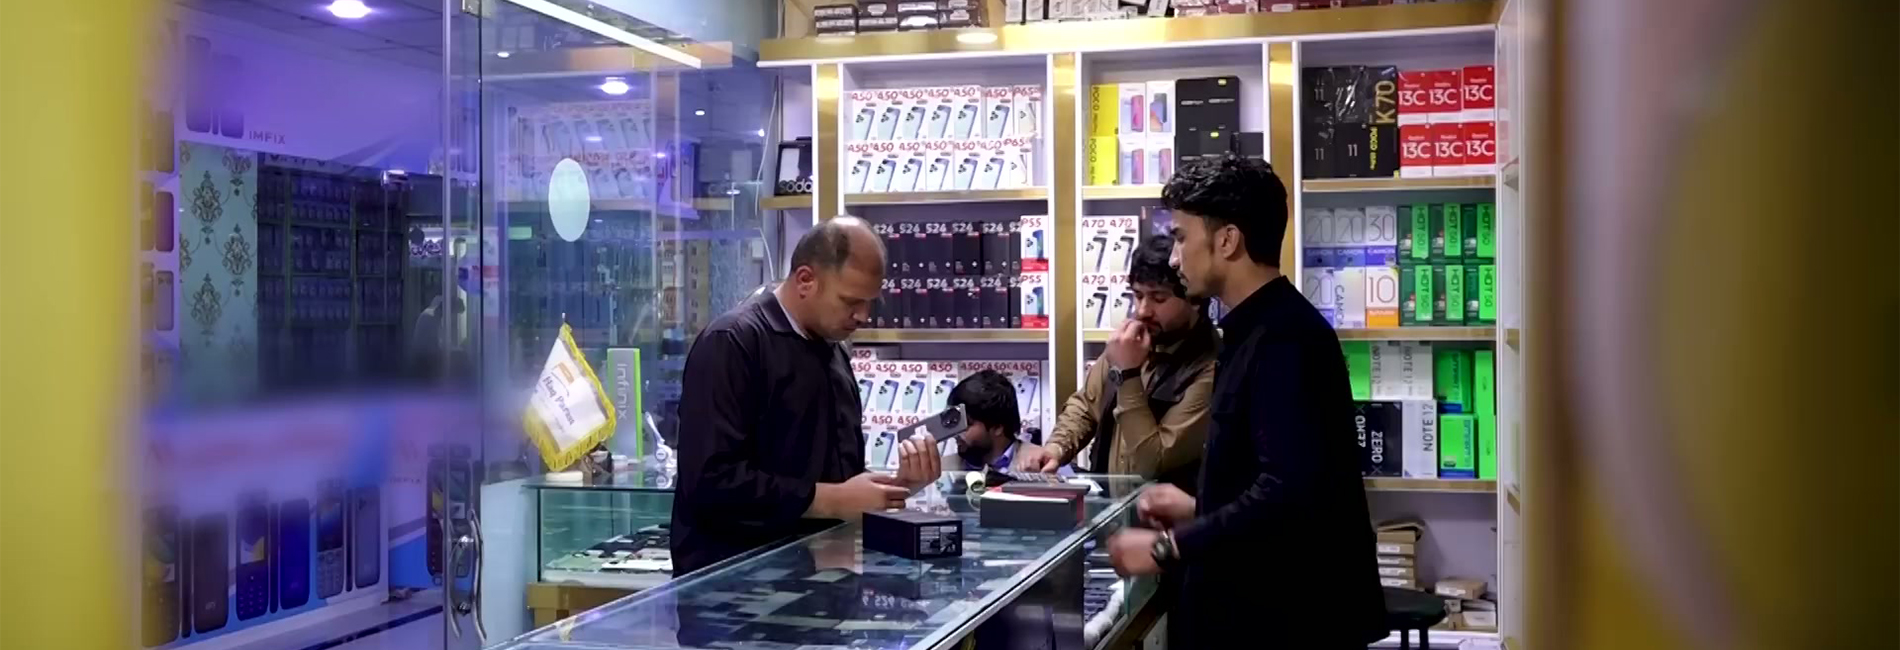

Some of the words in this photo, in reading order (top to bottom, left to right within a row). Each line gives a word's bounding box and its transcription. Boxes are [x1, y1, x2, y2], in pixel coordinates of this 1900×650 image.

[1398, 90, 1426, 106] 13C
[1429, 88, 1457, 105] 13C
[1464, 84, 1493, 101] 13C
[1375, 80, 1395, 123] K70
[1314, 148, 1324, 160] 11
[1348, 144, 1358, 157] 11
[1402, 141, 1431, 159] 13C
[1434, 141, 1463, 158] 13C
[1466, 140, 1495, 157] 13C
[1021, 218, 1042, 227] P55
[1082, 219, 1105, 228] A70
[1110, 218, 1133, 227] A70
[1337, 215, 1364, 243] 20
[1369, 214, 1395, 242] 30
[881, 278, 895, 289] 24
[1021, 274, 1042, 284] P55
[1082, 275, 1106, 285] A70
[1369, 275, 1396, 303] 10
[1372, 345, 1381, 372] NOTE
[876, 364, 897, 372] A50
[901, 364, 923, 372] A50
[930, 363, 953, 372] A50
[1422, 404, 1433, 415] 12
[872, 415, 893, 424] A50
[1422, 419, 1433, 452] NOTE
[1371, 431, 1383, 463] ZERO
